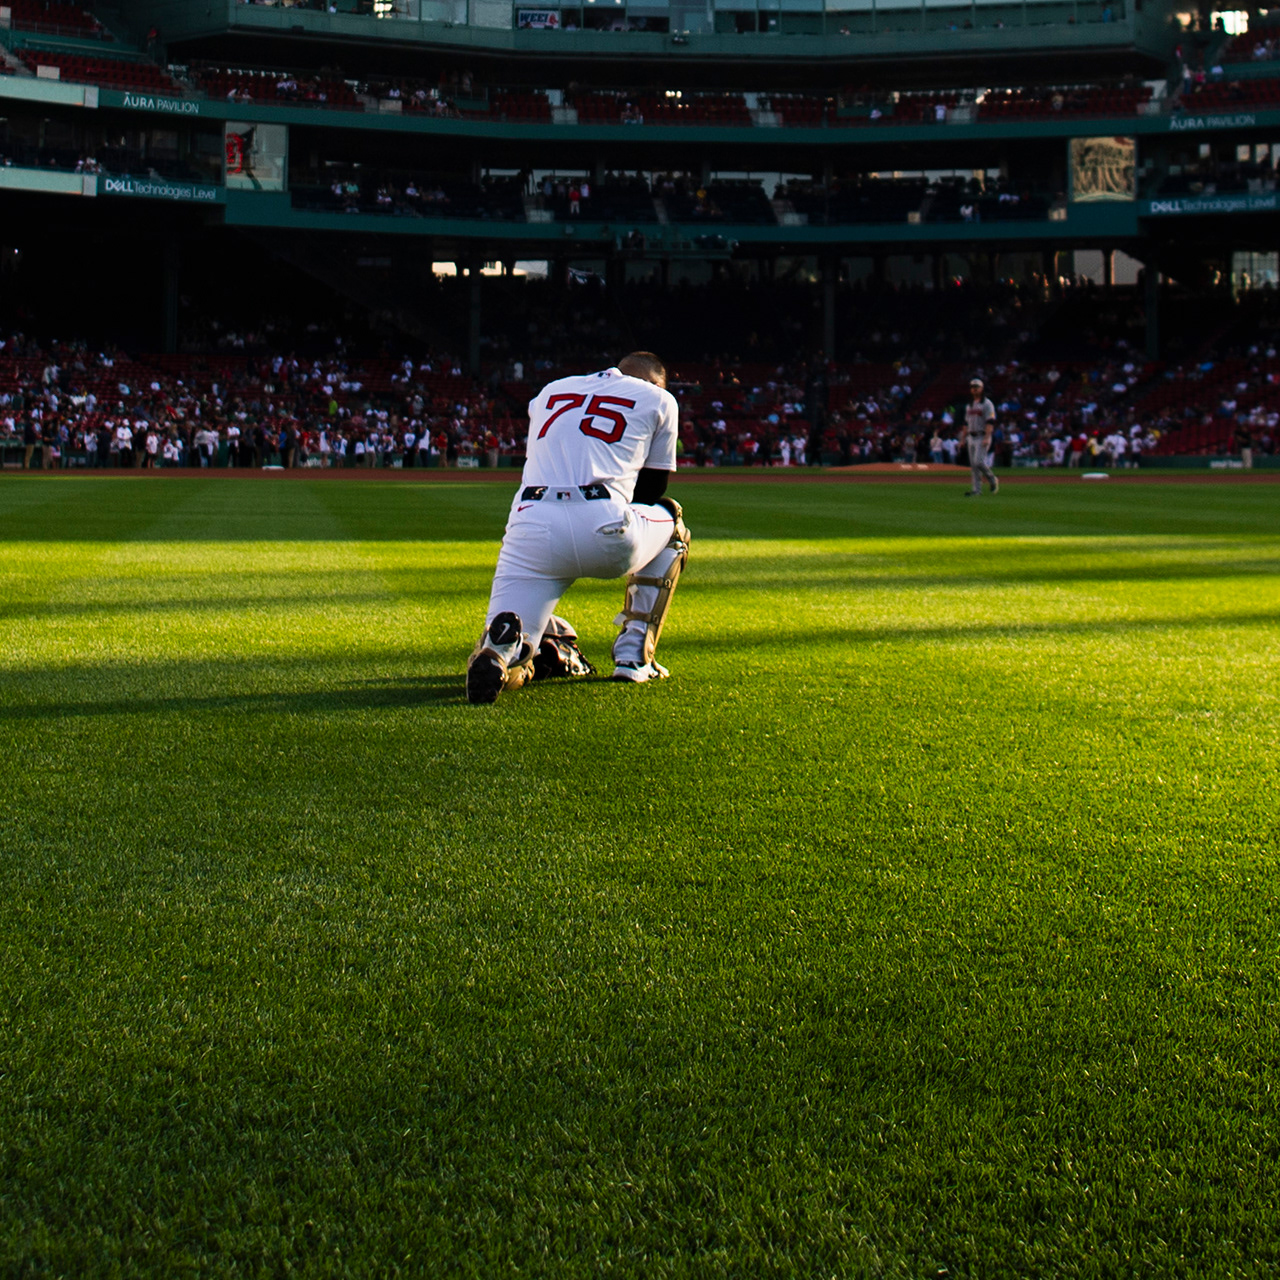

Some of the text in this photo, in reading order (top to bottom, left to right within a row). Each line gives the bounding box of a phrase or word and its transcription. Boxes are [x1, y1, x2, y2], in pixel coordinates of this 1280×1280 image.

[520, 12, 549, 23] WEEI
[156, 99, 200, 113] PAVILION
[1206, 115, 1256, 128] PAVILION
[105, 179, 217, 200] DELL Technologies Level
[1150, 200, 1182, 214] DELL
[537, 393, 636, 444] 75
